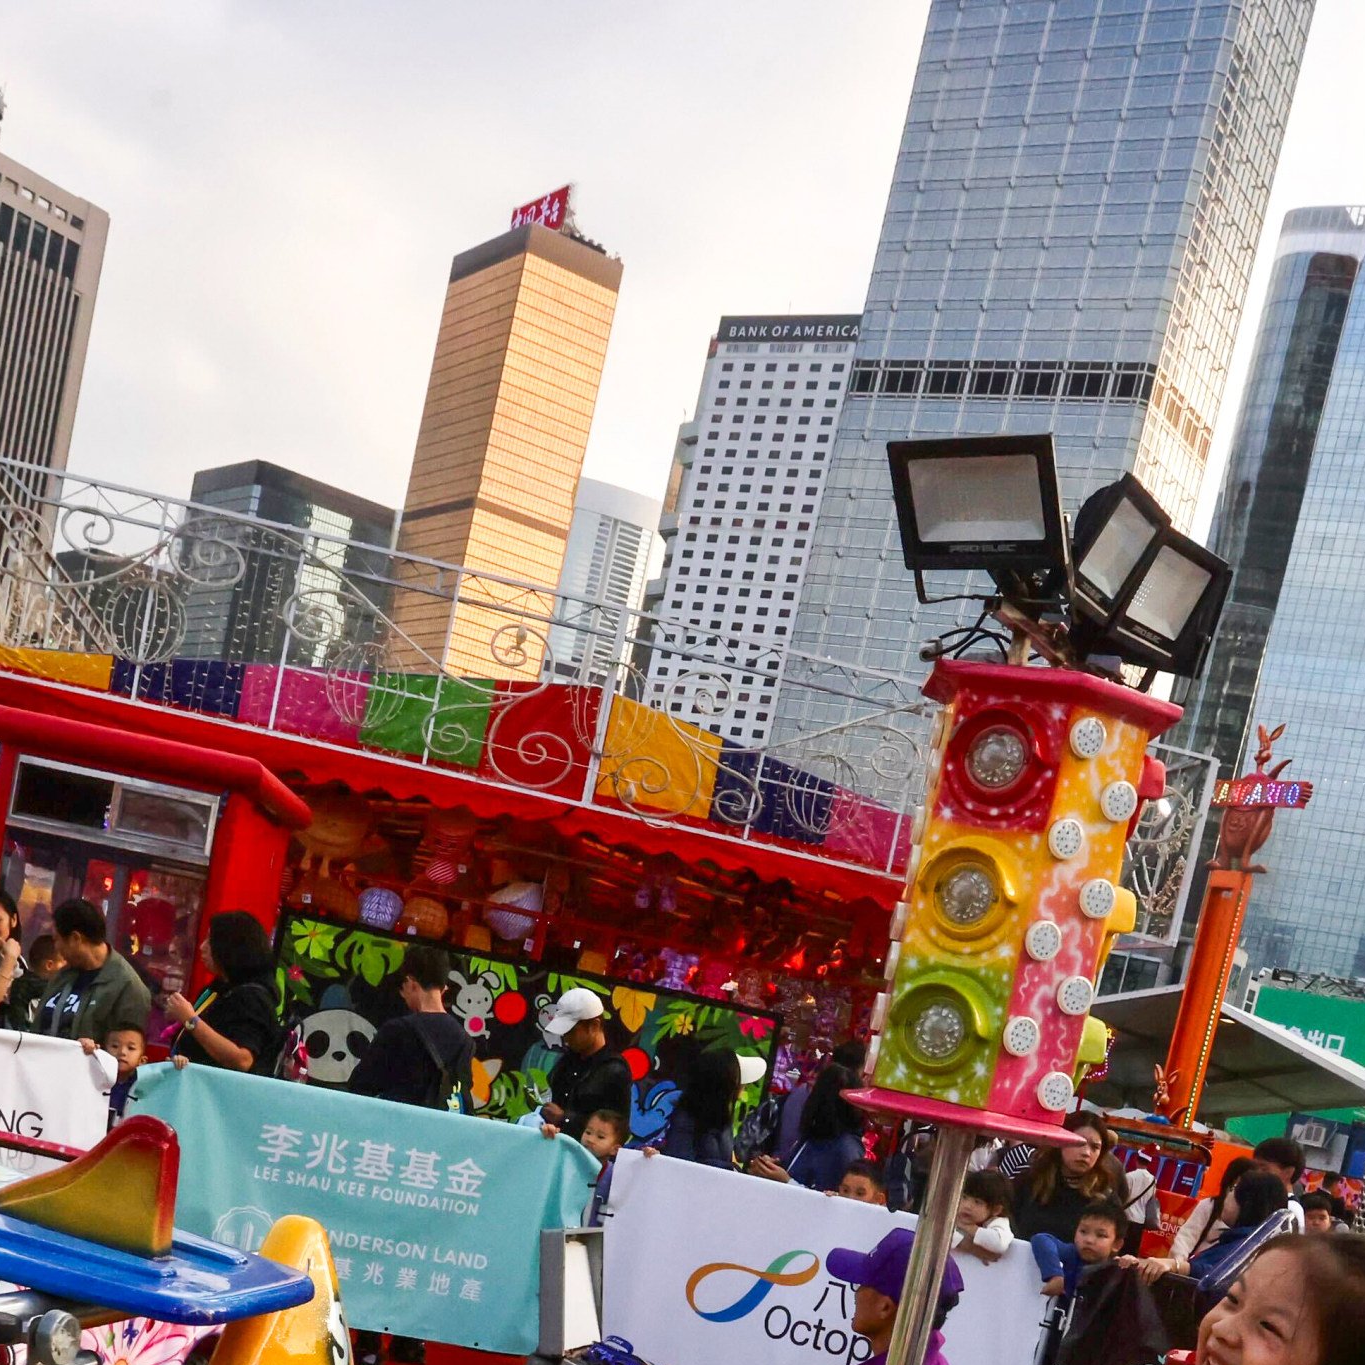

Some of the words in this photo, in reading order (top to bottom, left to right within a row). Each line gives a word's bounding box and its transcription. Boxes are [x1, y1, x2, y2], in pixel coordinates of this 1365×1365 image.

[729, 326, 767, 338] BANK
[771, 325, 791, 337] OF
[793, 325, 860, 337] AMERICA
[257, 1123, 488, 1198] 李兆基基金
[254, 1165, 281, 1183] LEE
[286, 1172, 331, 1192] SHAU
[337, 1180, 365, 1198] KEE
[371, 1185, 480, 1217] FOUNDATION
[326, 1228, 427, 1260] NDERSON
[432, 1246, 489, 1271] LAND
